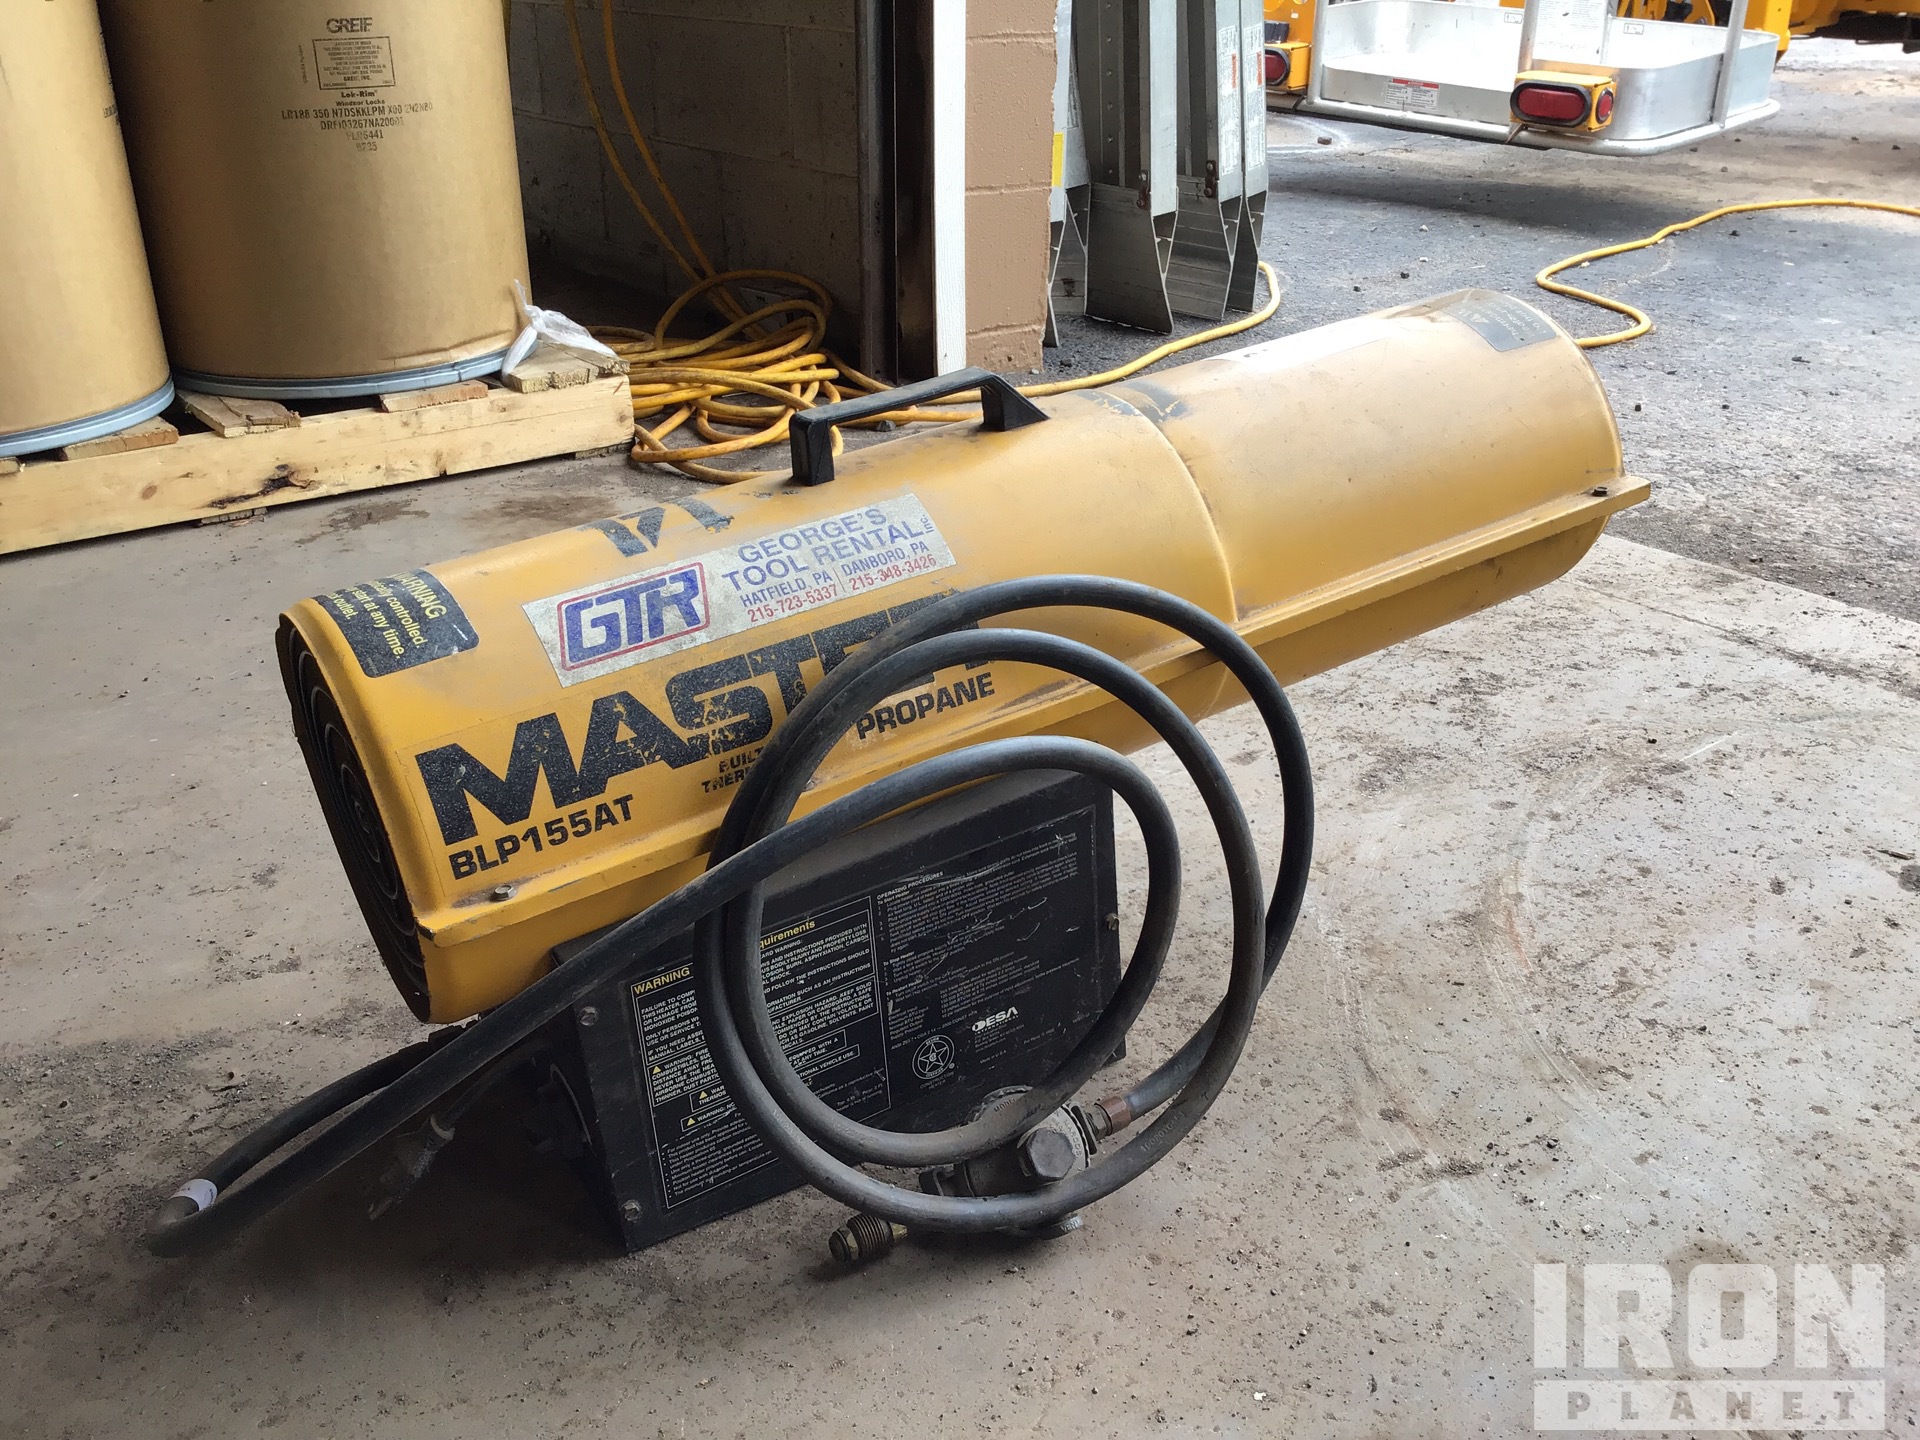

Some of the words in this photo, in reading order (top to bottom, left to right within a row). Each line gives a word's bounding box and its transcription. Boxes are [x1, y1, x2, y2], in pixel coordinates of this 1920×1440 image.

[326, 16, 373, 33] GREIF
[313, 108, 330, 119] 350
[721, 554, 810, 592] TOOL
[811, 520, 925, 566] RENTAL
[739, 576, 812, 608] HATFIELD,
[814, 570, 834, 587] PA
[840, 546, 911, 577] DANBORO,
[910, 540, 930, 556] PA
[747, 583, 841, 623] 215-723-5337
[849, 554, 938, 592] 215-348-3426
[333, 598, 359, 620] outlet.
[363, 602, 380, 611] at
[370, 611, 390, 628] any
[386, 596, 428, 649] controlled.
[564, 569, 701, 663] GTR
[382, 628, 405, 660] time.
[415, 588, 994, 846] MAST
[856, 672, 996, 740] PROPANE
[449, 794, 634, 880] BLP155AT
[633, 966, 690, 995] WARNING
[759, 919, 815, 949] quirements
[641, 1000, 666, 1014] FAILURE
[667, 996, 675, 1004] TO
[676, 989, 695, 1000] COMP
[770, 954, 783, 964] AND
[783, 939, 824, 959] INSTRUCTIONS
[824, 928, 852, 943] PROVIDED
[853, 922, 867, 932] WITH
[641, 1010, 655, 1020] THIS
[681, 995, 694, 1004] CAN
[770, 958, 790, 970] BODILY
[790, 950, 810, 962] INJURY
[810, 945, 822, 954] AND
[822, 934, 851, 949] PROPERTY
[851, 928, 866, 938] LOSS
[642, 1018, 652, 1026] OR
[653, 1007, 679, 1022] DAMAGE
[762, 966, 785, 979] LOSION,
[845, 933, 868, 946] CARBON
[644, 1015, 675, 1031] MONOXIDE
[769, 970, 791, 982] SHOCK.
[645, 1030, 661, 1041] ONLY
[661, 1019, 690, 1034] PERSONS
[771, 977, 794, 991] FOLLOW
[795, 972, 806, 981] THE
[807, 957, 846, 976] INSTRUCTIONS
[847, 947, 869, 961] SHOULD
[654, 1043, 667, 1053] YOU
[669, 1036, 685, 1047] NEED
[766, 992, 795, 1008] ORMATION
[796, 985, 812, 996] SUCH
[813, 981, 821, 989] AS
[831, 962, 870, 981] INSTRUCTIONS
[781, 1004, 812, 1021] EXPLOSION
[839, 988, 854, 998] KEEP
[855, 981, 871, 991] SOLID
[787, 1012, 806, 1025] PAPER
[857, 986, 871, 996] SAFE
[646, 1037, 658, 1047] USE
[659, 1033, 668, 1041] OR
[669, 1023, 694, 1037] SERVICE
[652, 1069, 681, 1086] DISTANCE
[683, 1062, 699, 1073] AWAY
[774, 1017, 808, 1036] OMMENDED
[810, 1013, 818, 1021] BY
[819, 1008, 830, 1017] THE
[653, 1079, 673, 1092] NEVER
[675, 1073, 687, 1083] USE
[689, 1068, 700, 1077] THE
[778, 1031, 787, 1040] DO
[788, 1027, 797, 1035] OR
[798, 1022, 810, 1031] MAY
[811, 1012, 835, 1026] CONTAIN
[836, 1001, 862, 1016] VOLATILE
[654, 1080, 685, 1097] AIRBORNE
[858, 1002, 873, 1012] PAINT
[683, 1080, 698, 1091] DUST
[782, 1036, 804, 1050] MICALS.
[710, 1084, 724, 1094] WAR
[817, 1039, 831, 1049] WITH
[799, 1065, 819, 1078] TIONAL
[819, 1055, 842, 1069] VEHICLE
[842, 1049, 855, 1059] USE.
[698, 1089, 726, 1105] THERMOS
[801, 1052, 812, 1062] ANY
